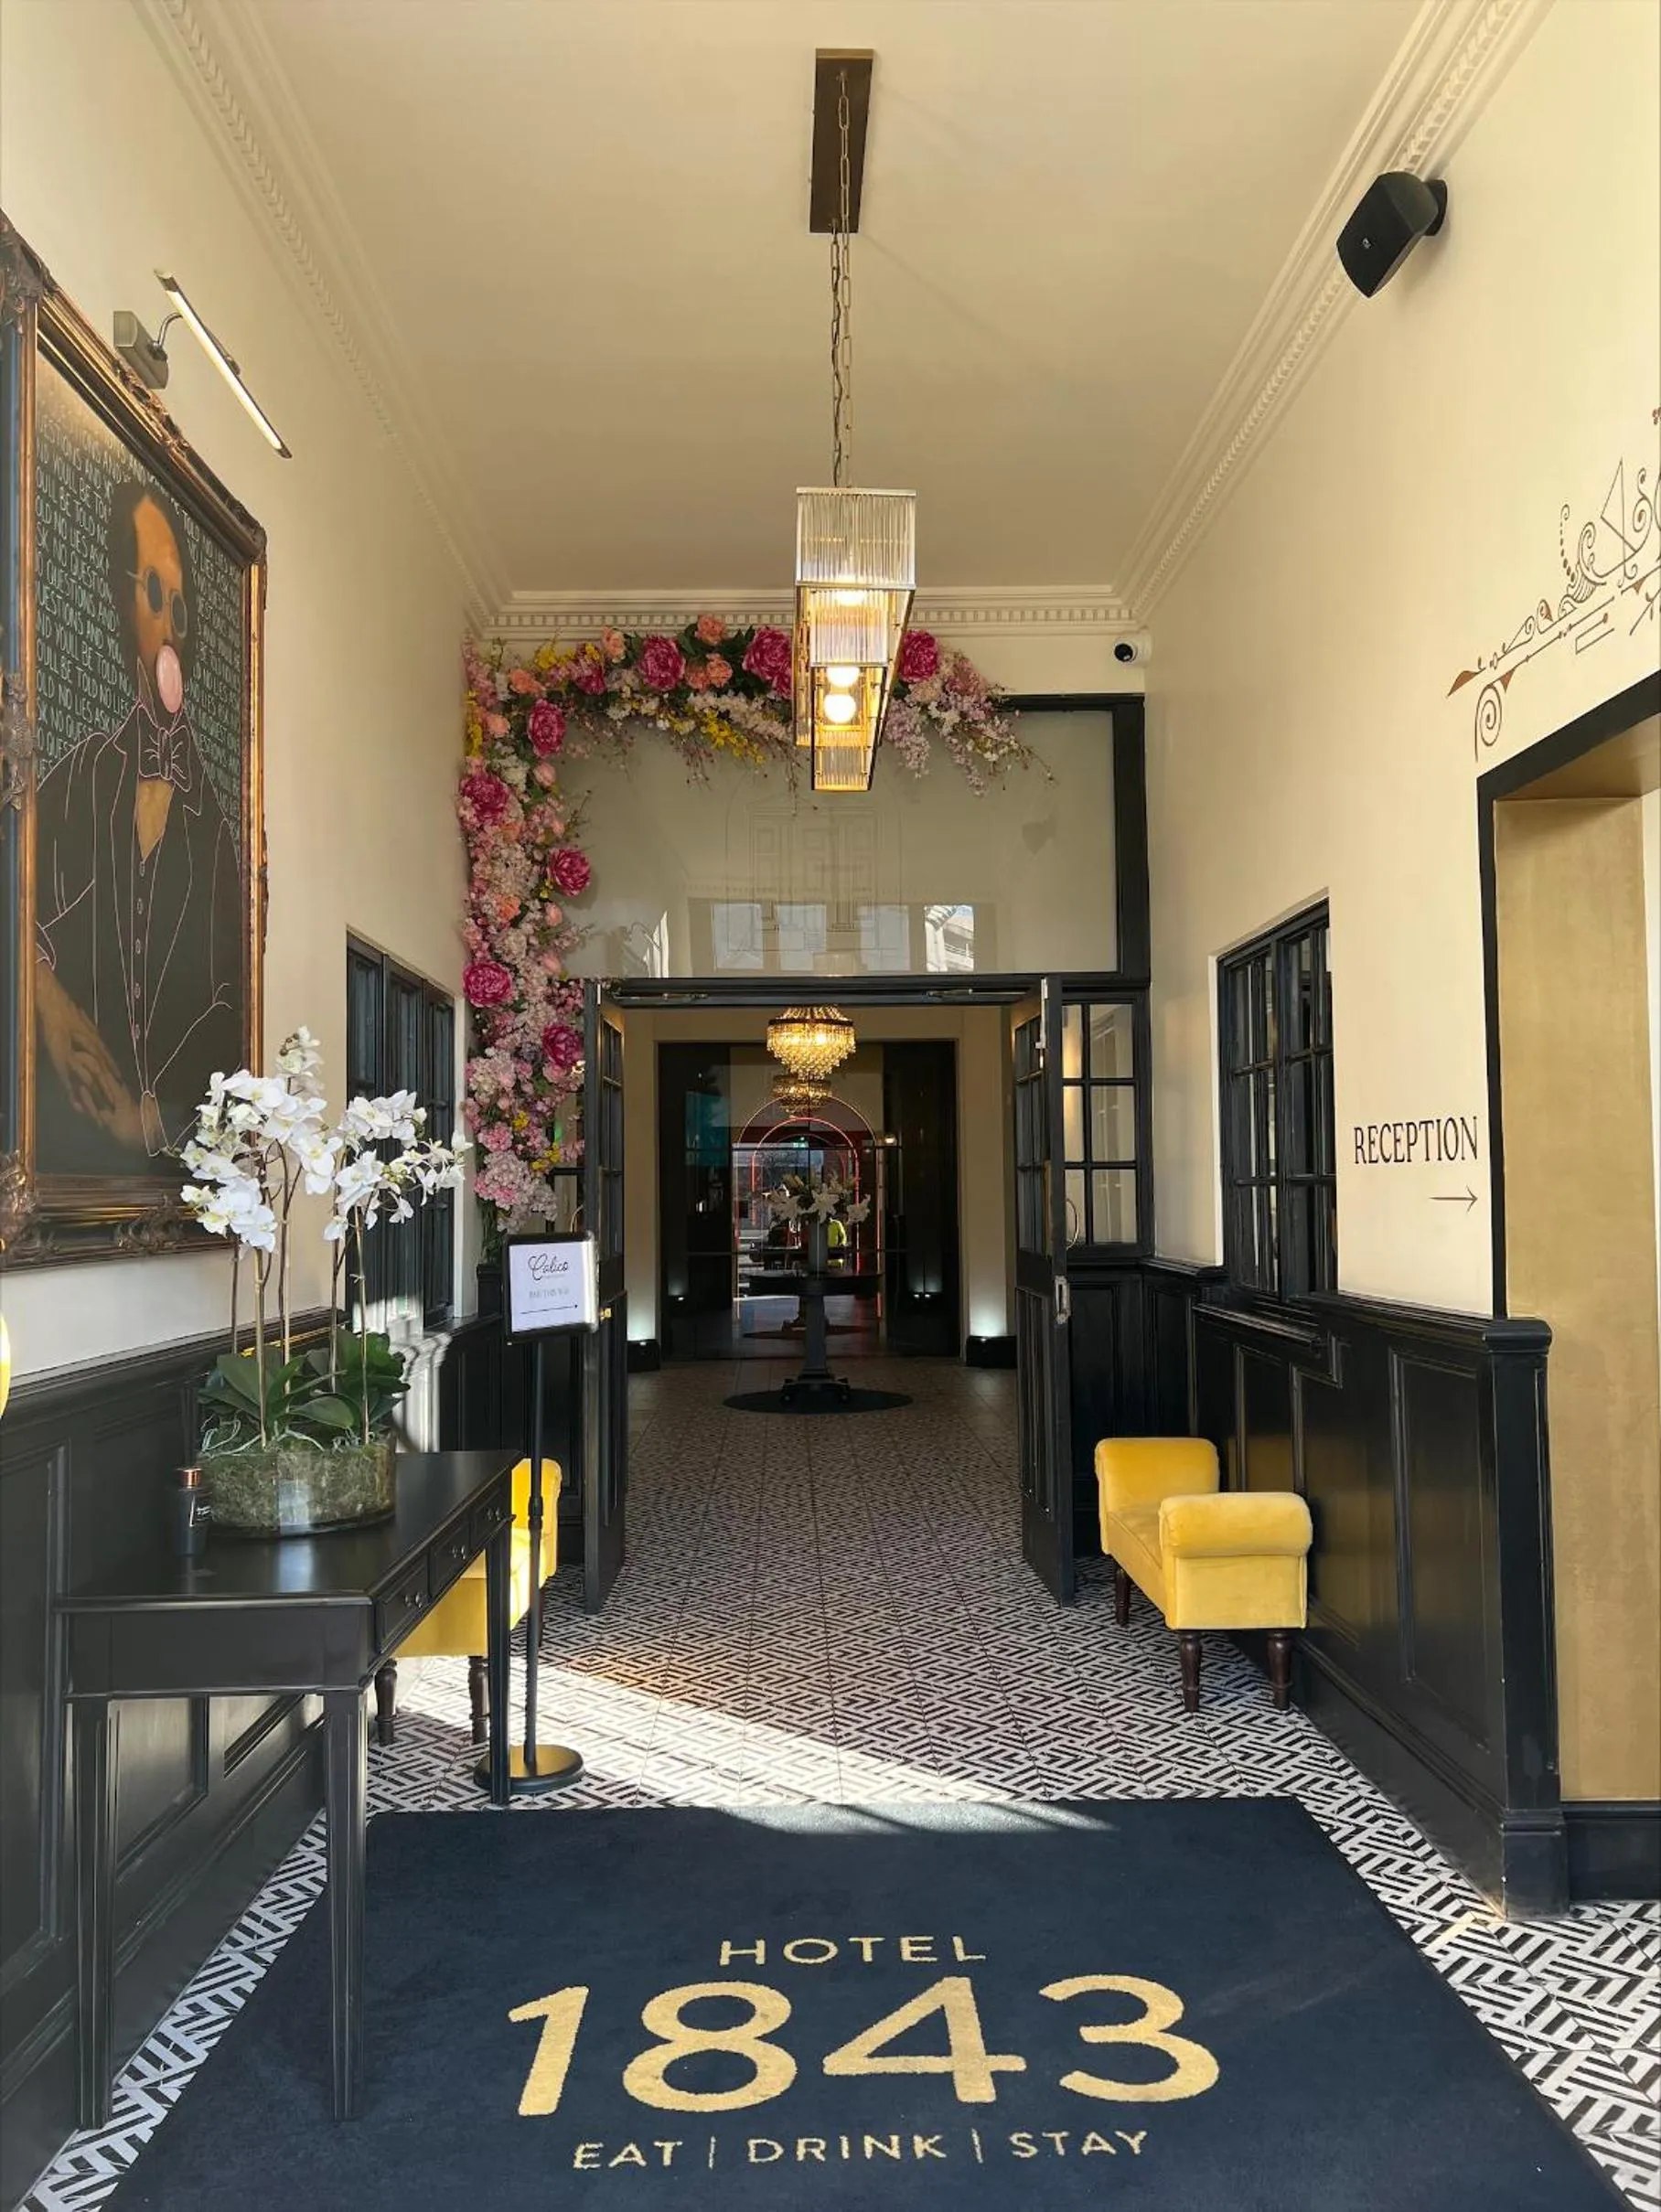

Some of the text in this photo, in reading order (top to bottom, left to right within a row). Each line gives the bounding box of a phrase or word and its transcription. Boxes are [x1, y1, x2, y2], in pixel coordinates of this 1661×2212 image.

[1354, 1116, 1478, 1164] RECEPTION
[528, 1253, 568, 1281] Calico
[720, 1937, 987, 1967] HOTEL
[508, 1975, 1220, 2117] 1843
[573, 2142, 680, 2170] EAT
[747, 2135, 947, 2164] DRINK
[1009, 2132, 1146, 2159] STAY
